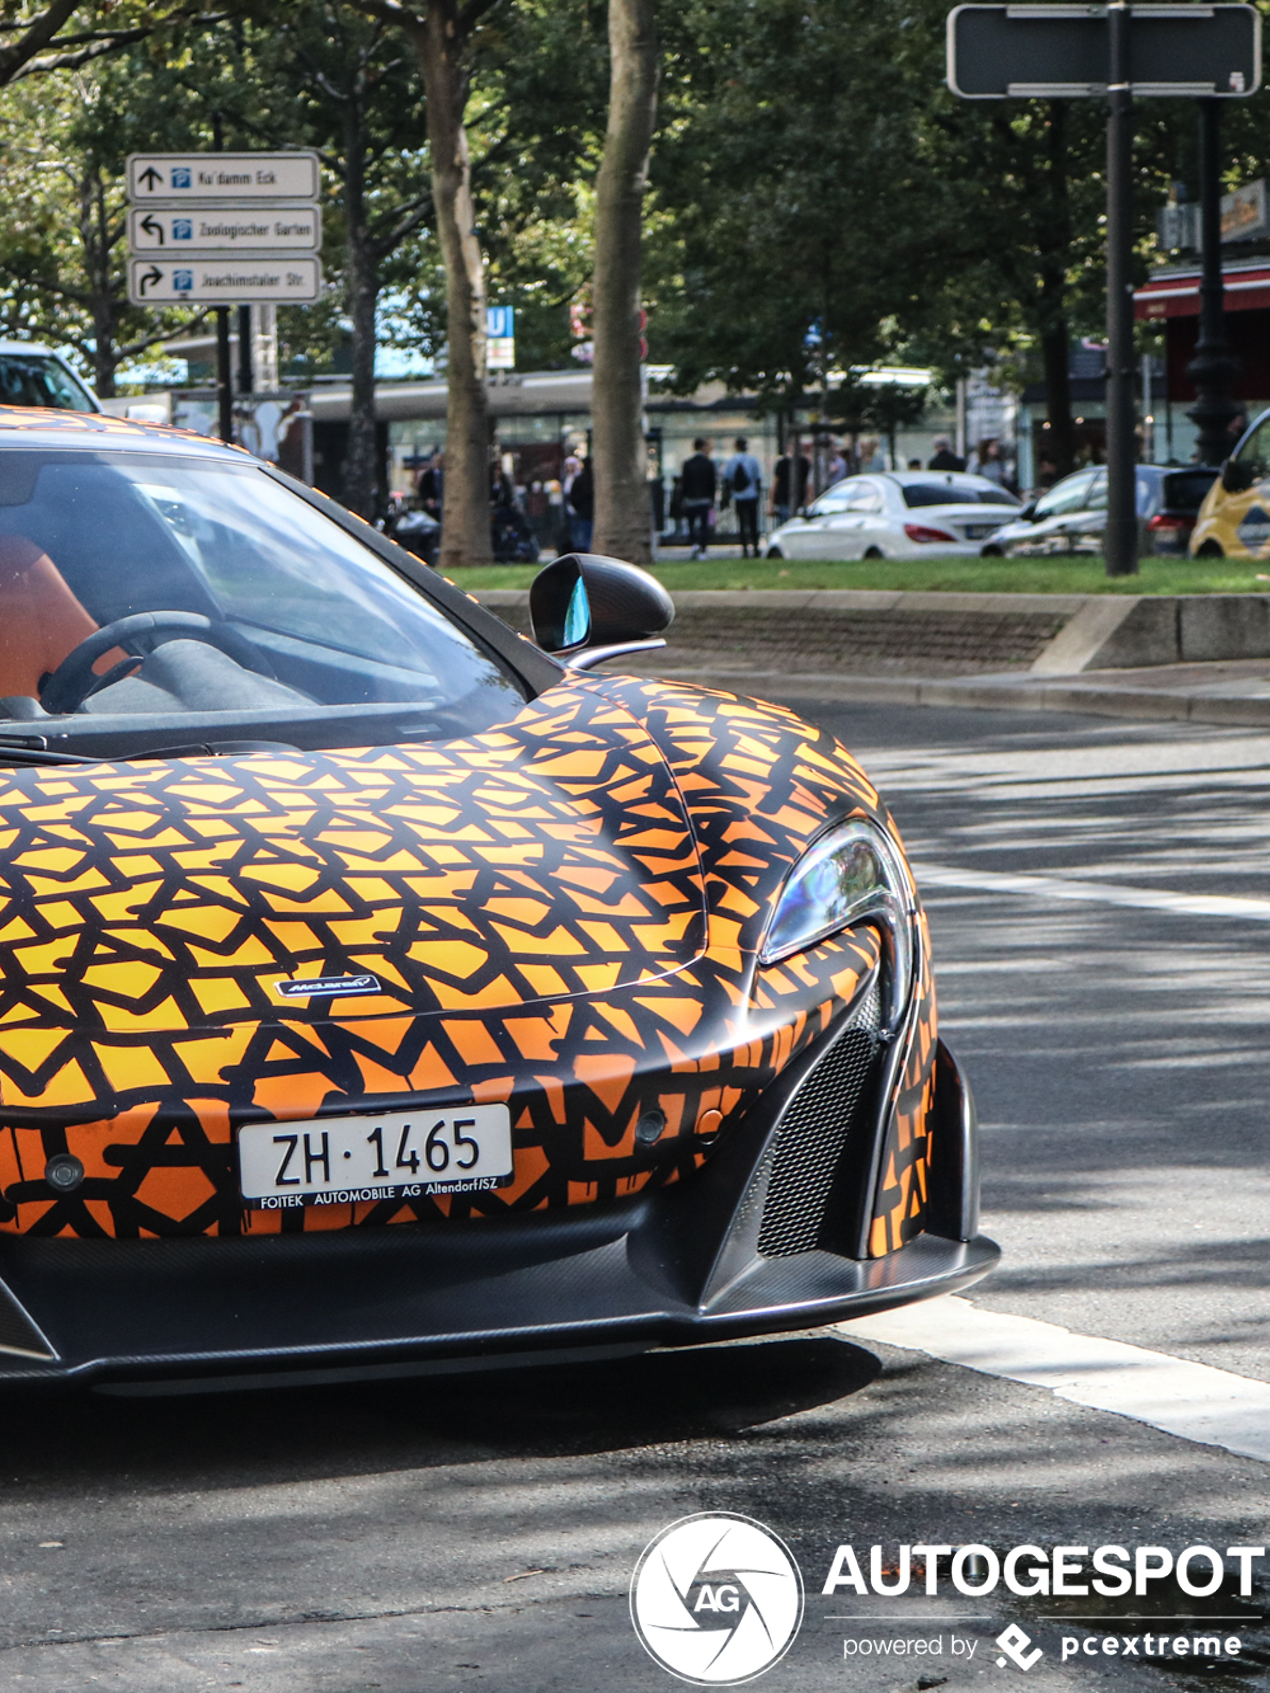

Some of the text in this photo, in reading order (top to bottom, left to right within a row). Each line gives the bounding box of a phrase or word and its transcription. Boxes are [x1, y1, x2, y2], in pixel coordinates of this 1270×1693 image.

[256, 170, 276, 185] Eck
[200, 221, 269, 240] Zoologischer
[273, 221, 312, 236] Garten
[288, 979, 367, 993] McLaren
[366, 1118, 480, 1178] 1465
[260, 1177, 499, 1210] FOITEK AUTOMOBILE AG Altendorf/SZ
